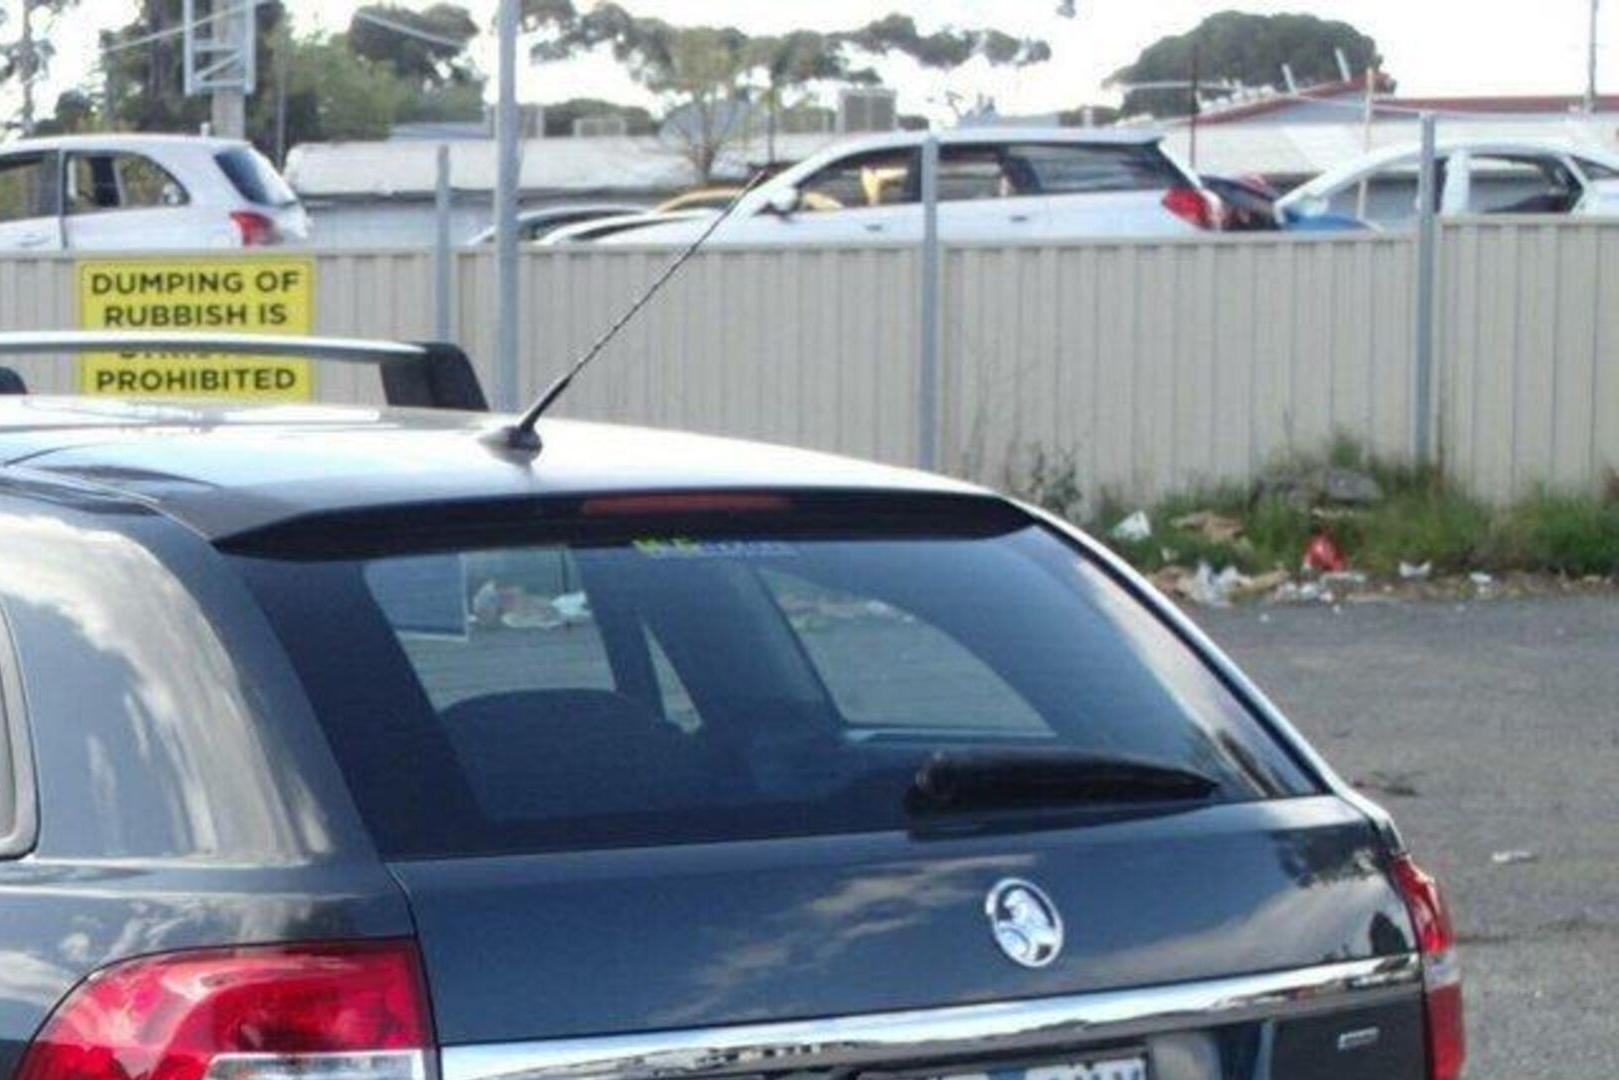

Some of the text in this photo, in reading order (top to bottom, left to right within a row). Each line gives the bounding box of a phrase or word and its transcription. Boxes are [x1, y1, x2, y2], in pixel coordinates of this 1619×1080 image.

[91, 270, 301, 295] DUMPING OF
[104, 302, 287, 327] RUBBISH IS
[96, 368, 296, 391] PROHIBITED
